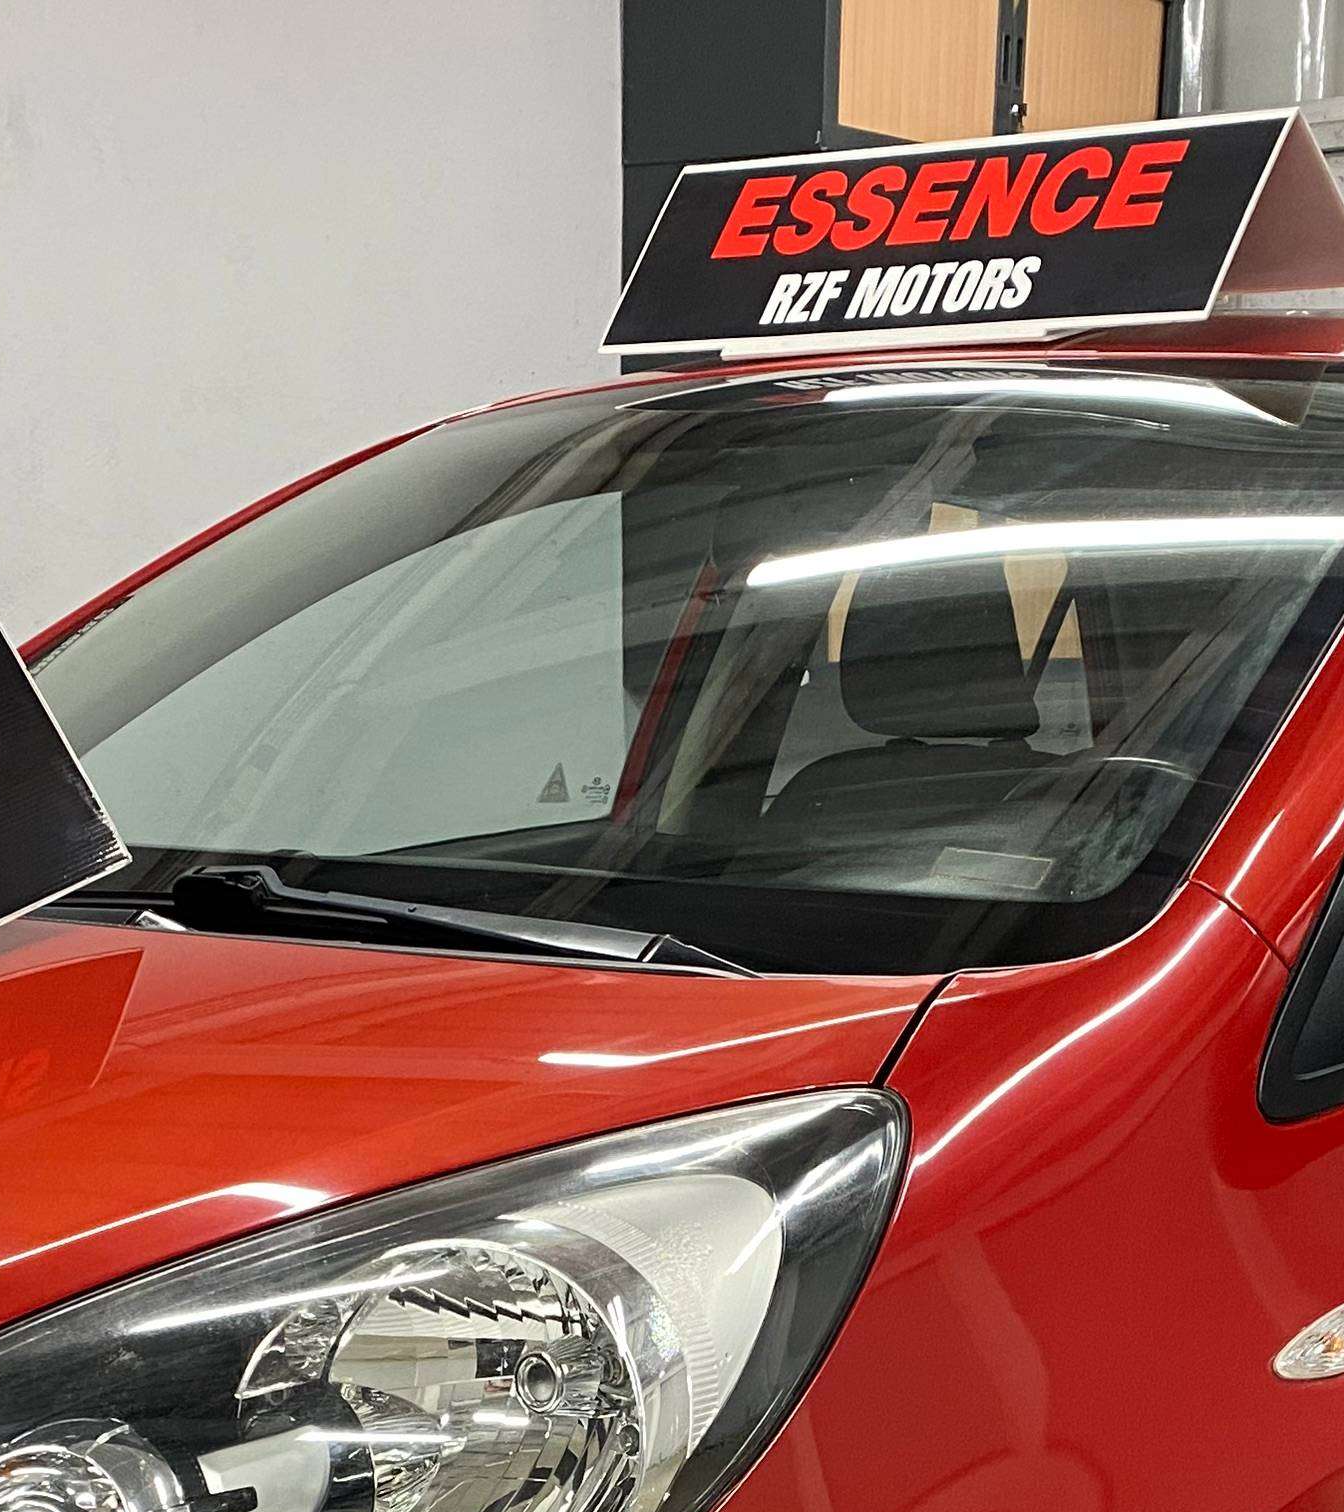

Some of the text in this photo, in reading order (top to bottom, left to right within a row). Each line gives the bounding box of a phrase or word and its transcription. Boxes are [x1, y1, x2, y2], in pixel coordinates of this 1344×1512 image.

[711, 140, 1190, 260] ESSENCE
[759, 256, 1042, 325] RZF MOTORS
